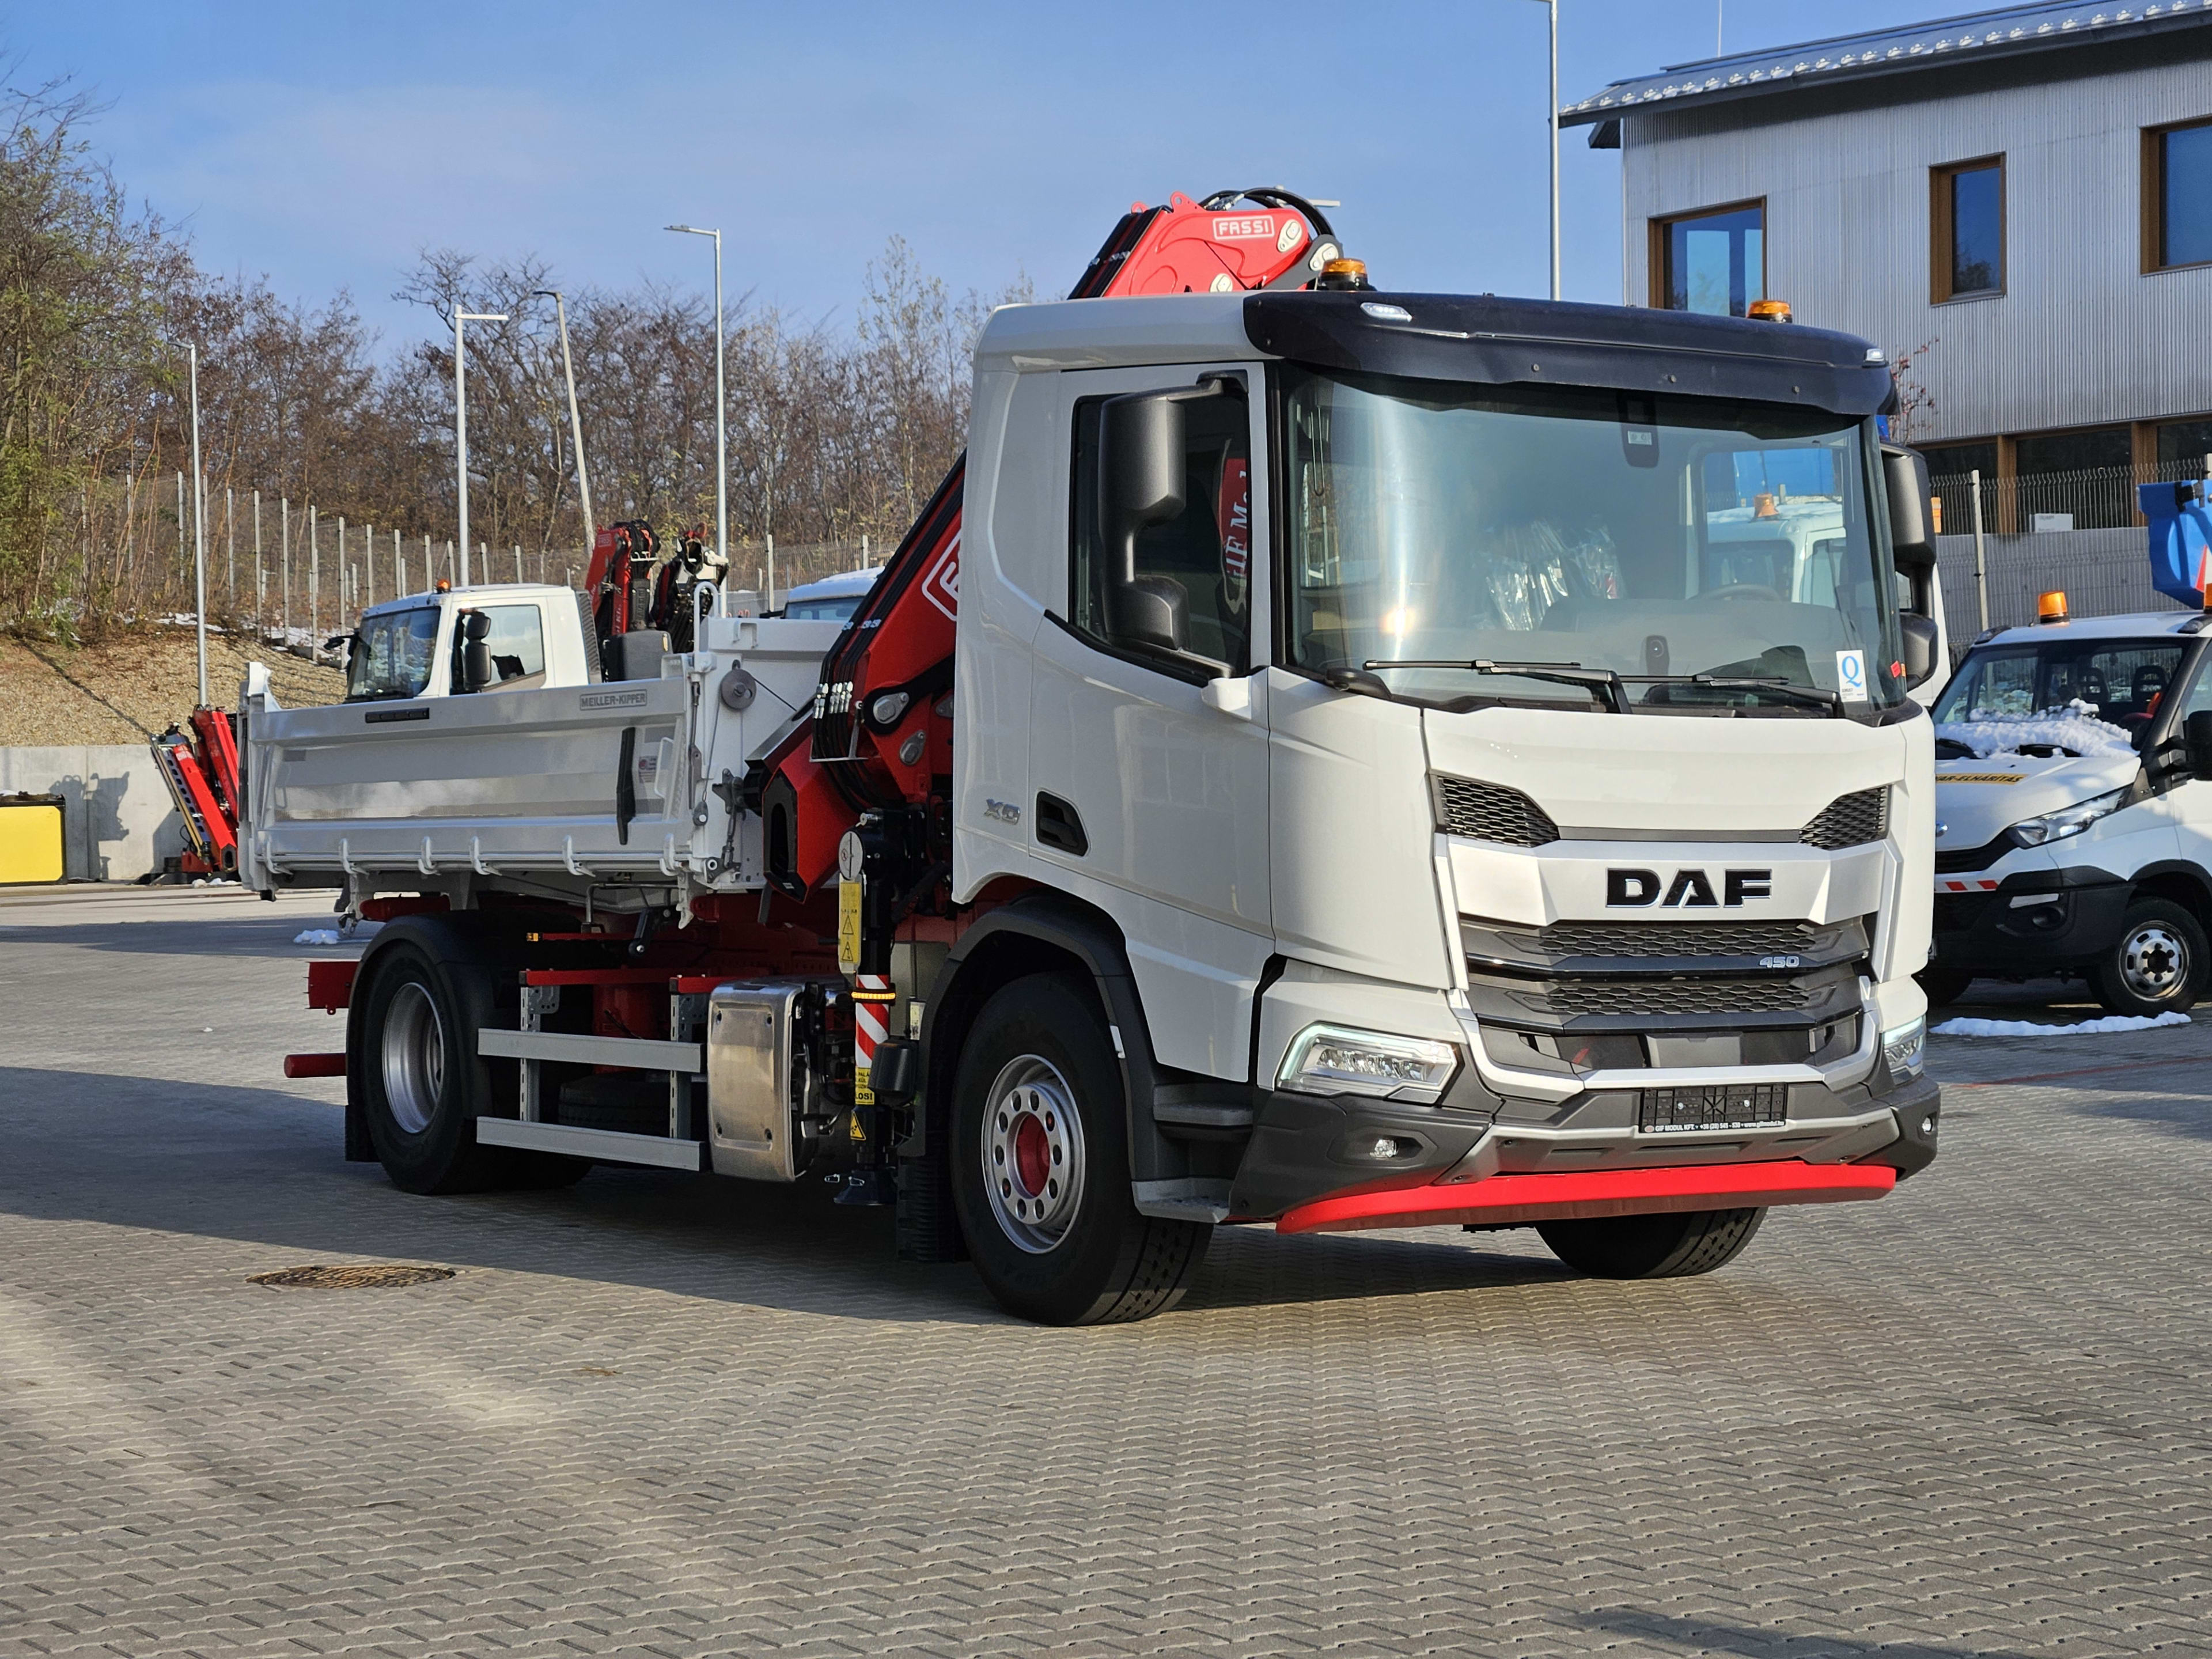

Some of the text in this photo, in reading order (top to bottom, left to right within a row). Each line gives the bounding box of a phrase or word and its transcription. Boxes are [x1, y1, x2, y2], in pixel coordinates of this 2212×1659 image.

[1219, 220, 1269, 235] FASSI
[1842, 656, 1862, 687] Q
[1605, 867, 1772, 908] DAF
[1759, 956, 1800, 968] 450
